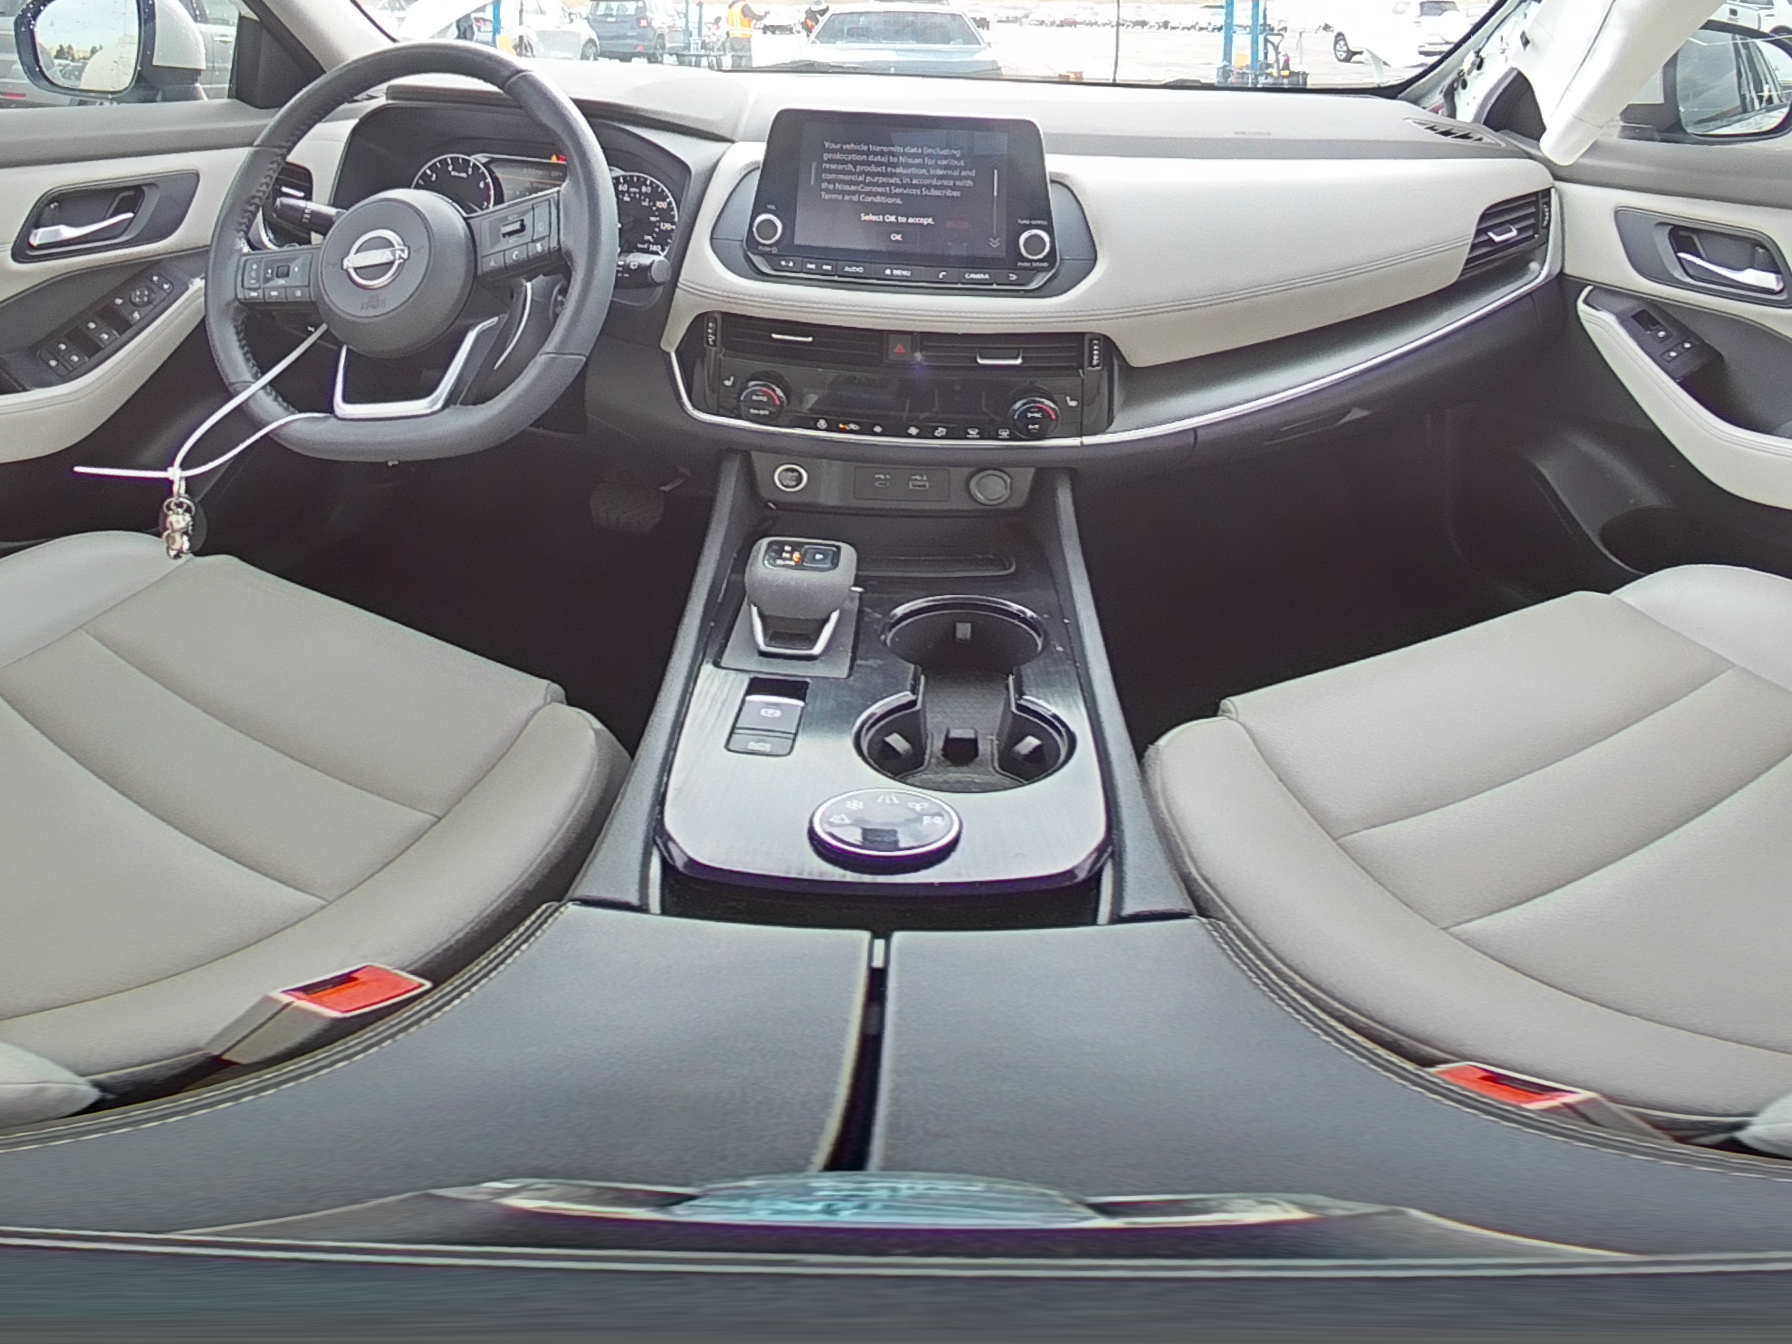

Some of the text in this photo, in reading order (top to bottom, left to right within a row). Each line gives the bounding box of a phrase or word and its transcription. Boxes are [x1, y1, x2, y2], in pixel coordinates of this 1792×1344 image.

[824, 141, 842, 149] Your
[842, 142, 868, 151] vehicle
[869, 144, 903, 153] transmits
[904, 145, 922, 153] data
[823, 152, 965, 166] geolocation data) to Nissan for various
[822, 163, 855, 172] research,
[856, 164, 886, 173] product
[929, 167, 960, 176] internal
[821, 173, 865, 182] commercial
[902, 176, 910, 184] in
[911, 177, 954, 186] accordance
[955, 179, 974, 187] with
[618, 184, 628, 192] 60
[641, 186, 651, 194] 80
[835, 182, 890, 193] NissanConnect
[890, 185, 921, 195] Services
[922, 187, 961, 197] Subscriber
[820, 191, 843, 200] Terms
[843, 193, 859, 201] and
[656, 201, 668, 209] 100
[860, 213, 935, 226] Select OK to accept.
[660, 222, 672, 230] 120
[890, 233, 903, 241] OK
[342, 245, 410, 270] NAN
[892, 269, 911, 277] MENU
[964, 272, 990, 280] CAMERA
